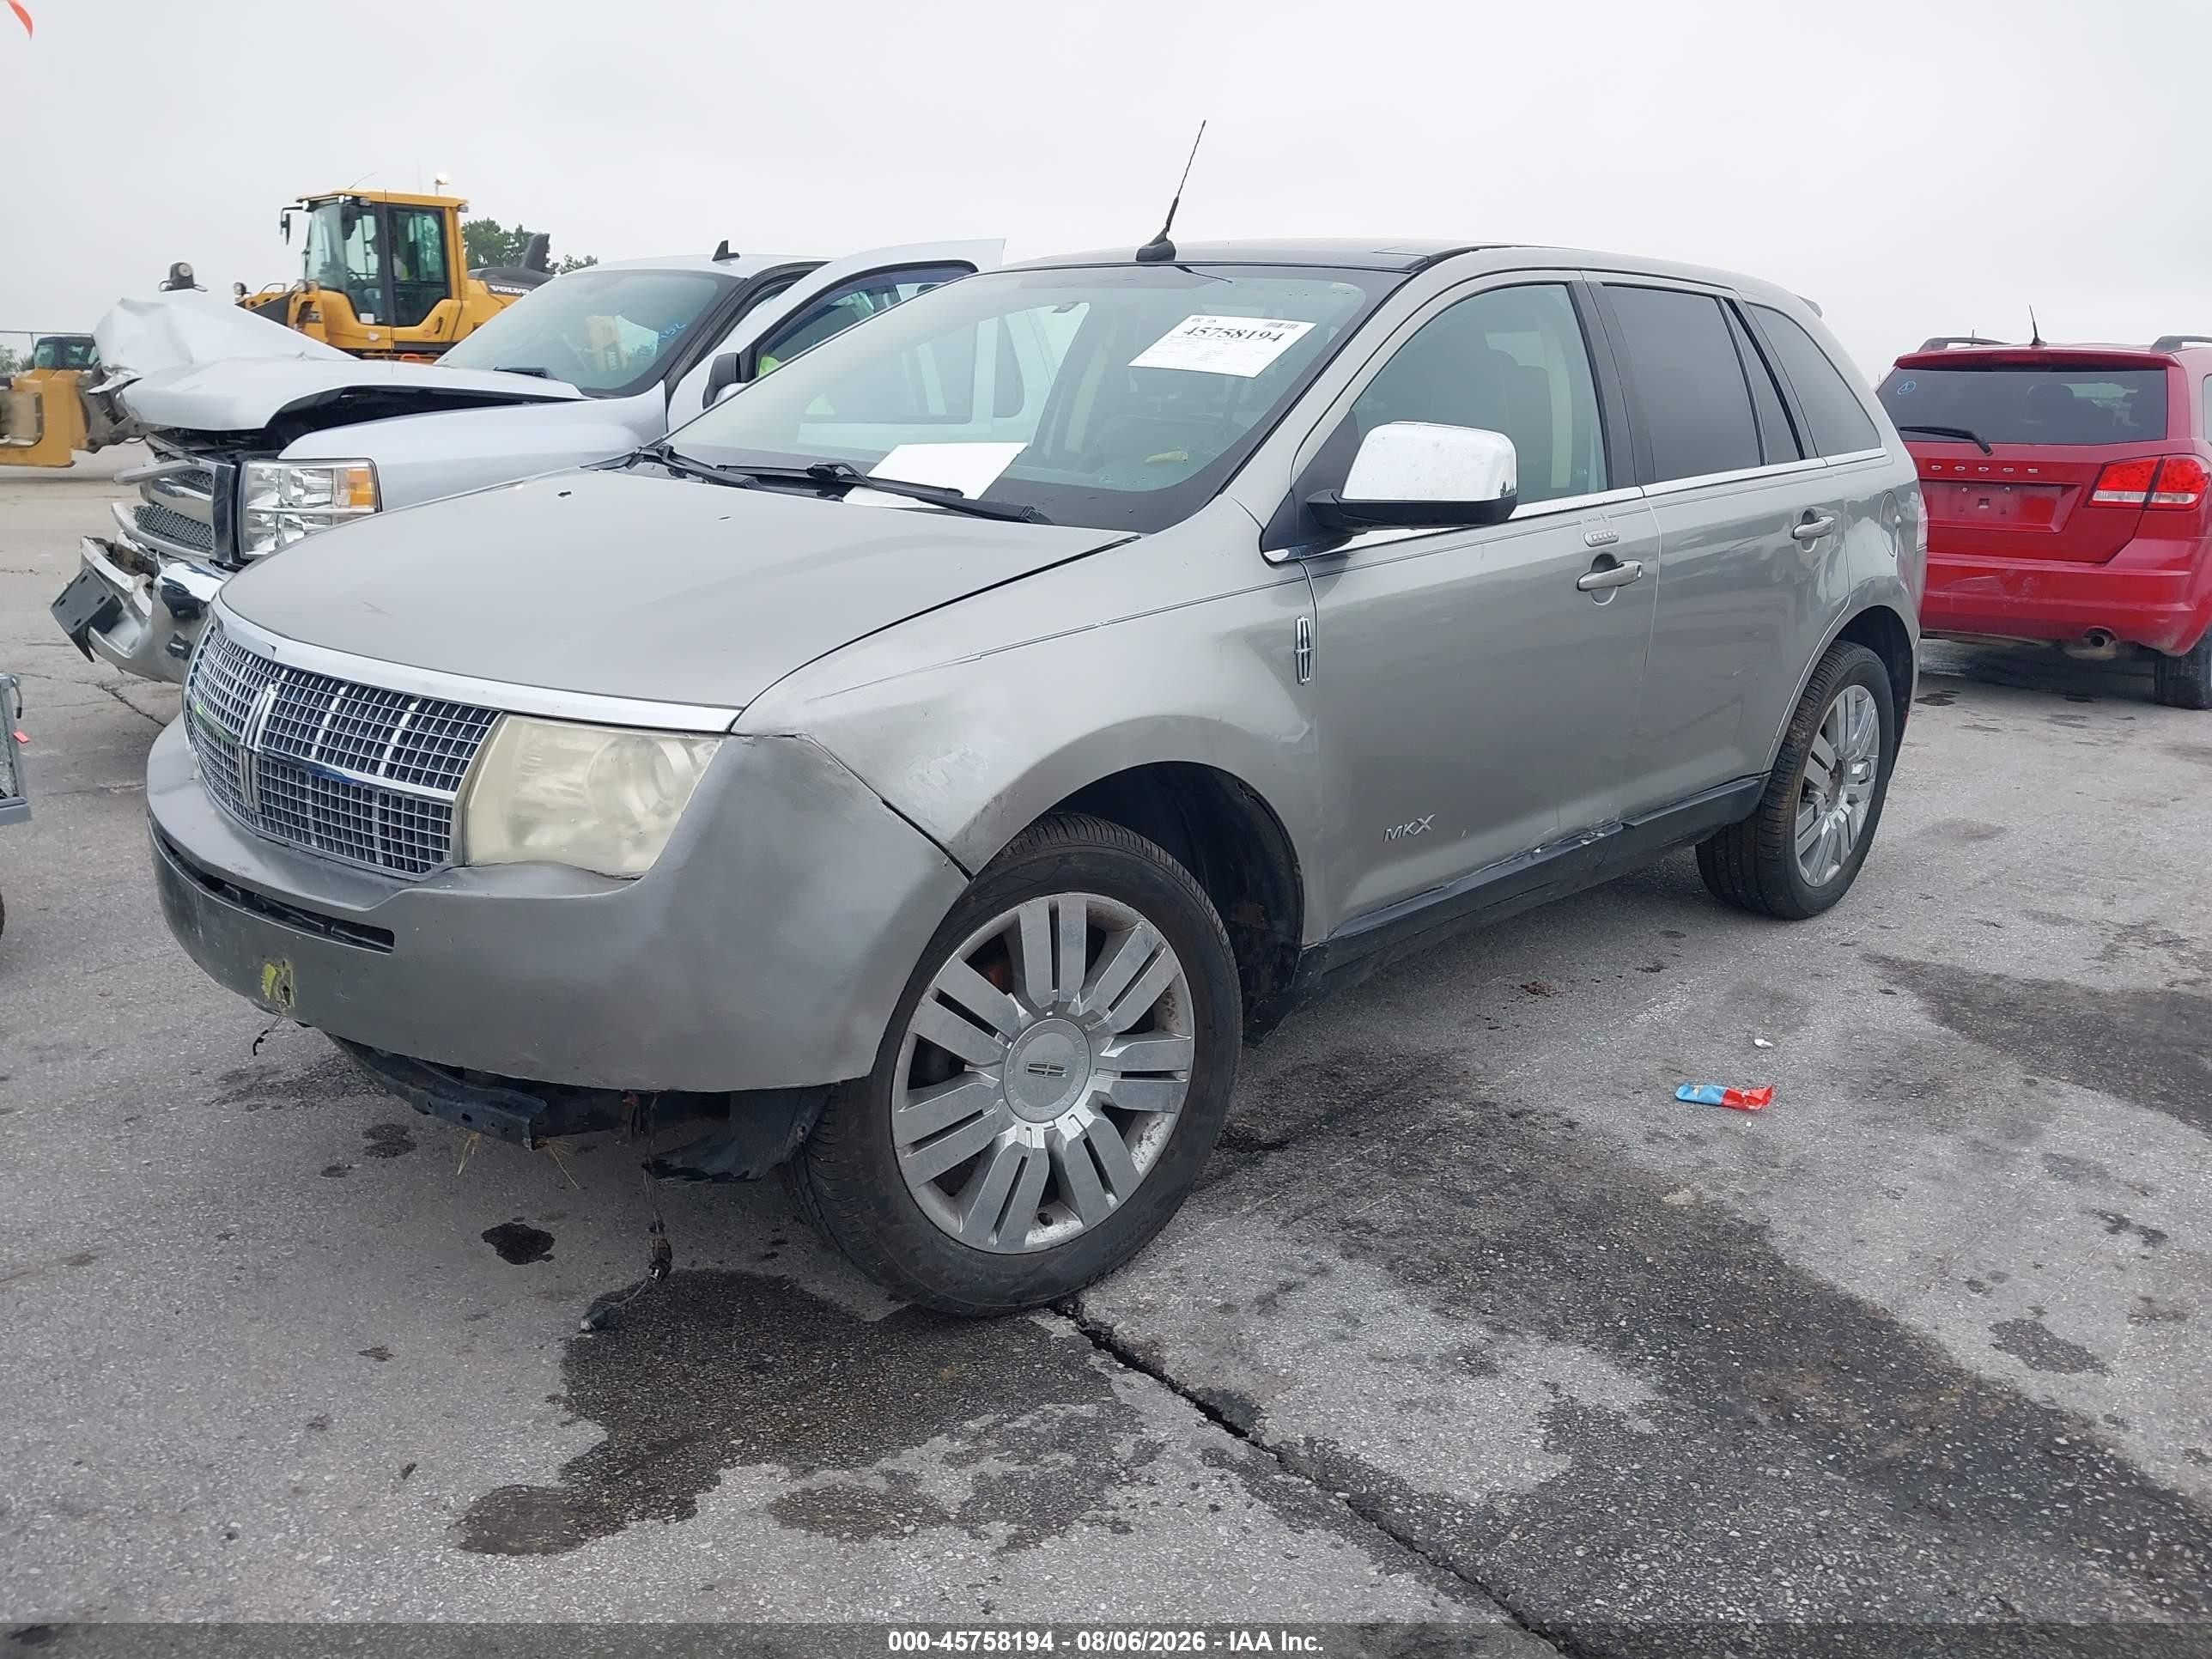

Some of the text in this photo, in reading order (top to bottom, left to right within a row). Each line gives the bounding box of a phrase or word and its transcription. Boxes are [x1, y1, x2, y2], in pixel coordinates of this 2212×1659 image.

[489, 284, 531, 295] VOLVO
[1183, 326, 1285, 343] 45758194
[1930, 464, 2039, 475] DODGE
[1382, 812, 1437, 843] MKX
